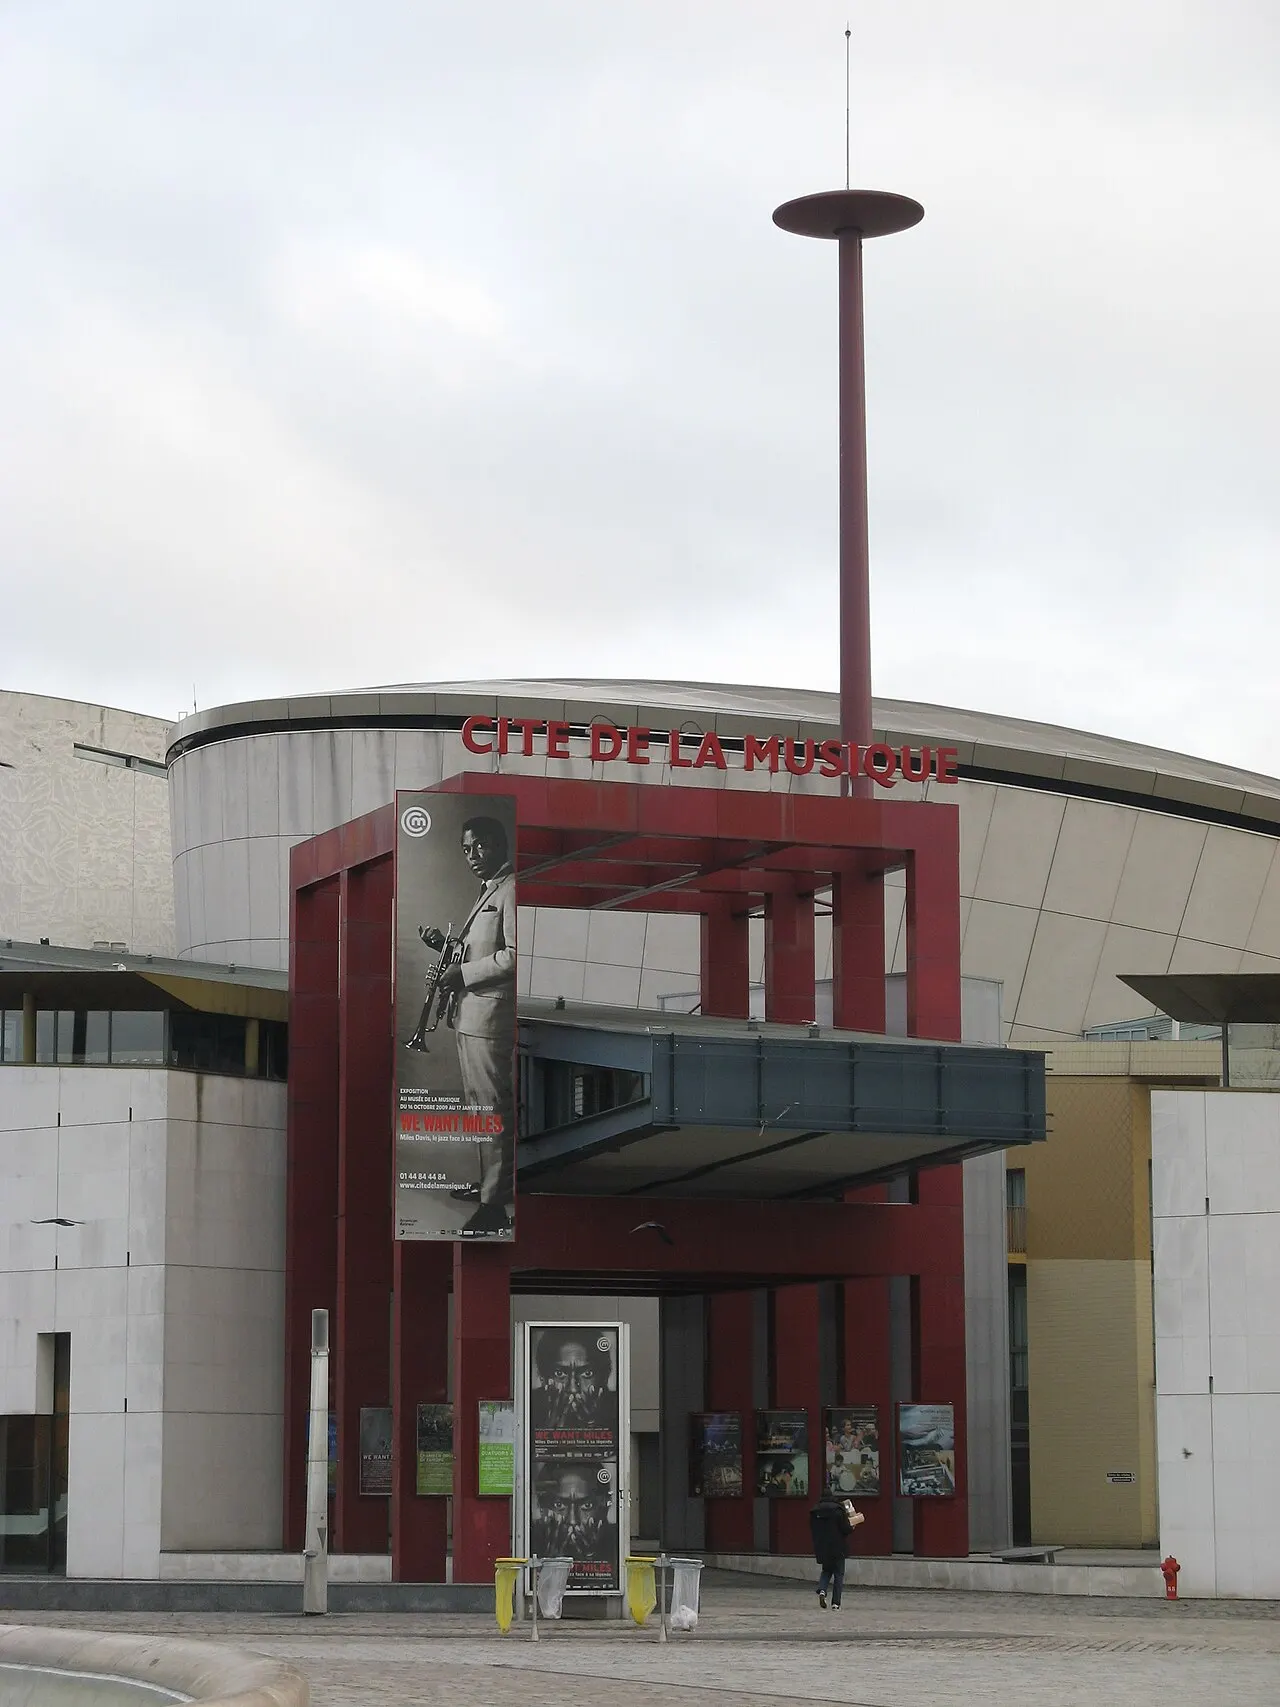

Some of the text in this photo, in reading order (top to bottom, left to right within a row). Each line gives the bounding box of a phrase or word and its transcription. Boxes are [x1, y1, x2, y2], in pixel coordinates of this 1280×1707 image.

[461, 715, 959, 788] CITE DE LA MUSIQUE
[400, 1114, 504, 1134] WE WANT MILES
[437, 1135, 449, 1143] jazz
[472, 1135, 493, 1143] légende
[400, 1172, 407, 1180] 01
[400, 1182, 472, 1191] www.citedelamusique.fr
[535, 1431, 613, 1440] WE WANT MILES
[583, 1563, 613, 1572] MILES
